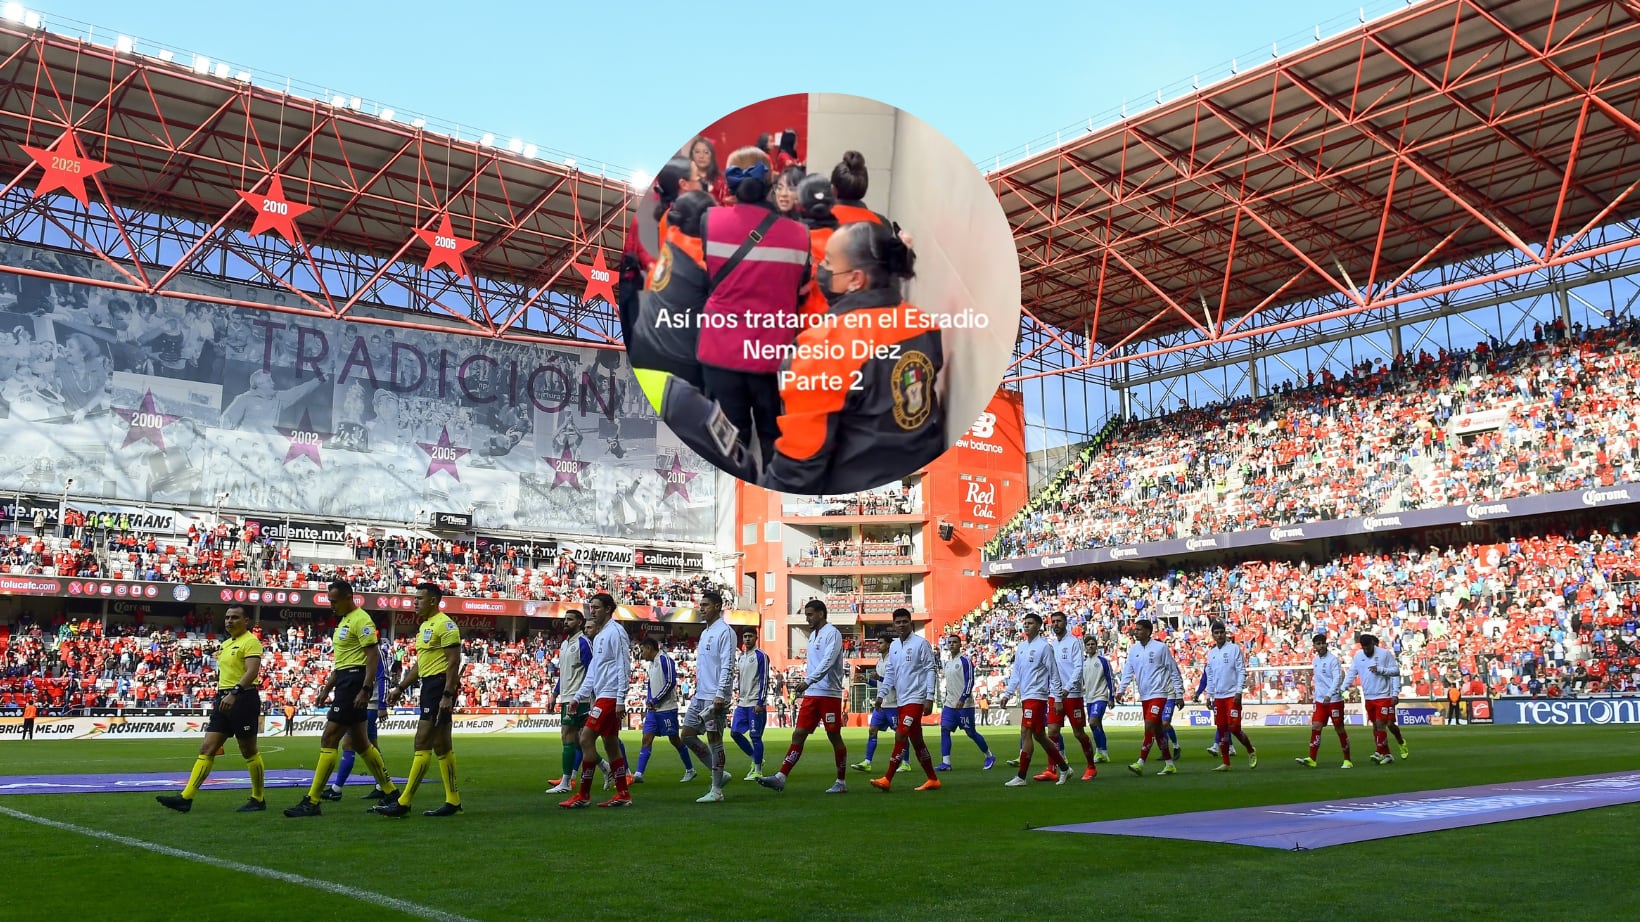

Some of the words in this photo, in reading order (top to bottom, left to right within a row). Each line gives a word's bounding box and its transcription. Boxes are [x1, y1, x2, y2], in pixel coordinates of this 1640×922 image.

[51, 156, 81, 174] 2025
[263, 199, 288, 216] 2010
[434, 235, 456, 250] 2005
[591, 269, 610, 283] 2000
[252, 319, 616, 421] TRADICIÓN
[131, 412, 163, 429] 2000
[291, 430, 319, 446] 2002
[431, 446, 456, 461] 2005
[970, 439, 1003, 454] balance
[556, 460, 578, 474] 2008
[667, 471, 686, 485] 2010
[965, 482, 996, 504] Red
[1582, 487, 1630, 507] Corona
[1466, 502, 1509, 519] Corona
[1363, 515, 1401, 531] Corona
[261, 523, 345, 542] caliente.mx
[1269, 527, 1304, 541] Corona
[1186, 537, 1217, 551] Corona
[644, 551, 703, 567] caliente.mx
[1110, 547, 1139, 560] Corona
[1041, 555, 1067, 568] Corona
[0, 580, 56, 590] tolucafc.com
[108, 722, 176, 733] ROSHFRANS
[466, 720, 494, 729] MEJOR
[1278, 715, 1303, 725] LIGA
[35, 724, 75, 734] MEJOR
